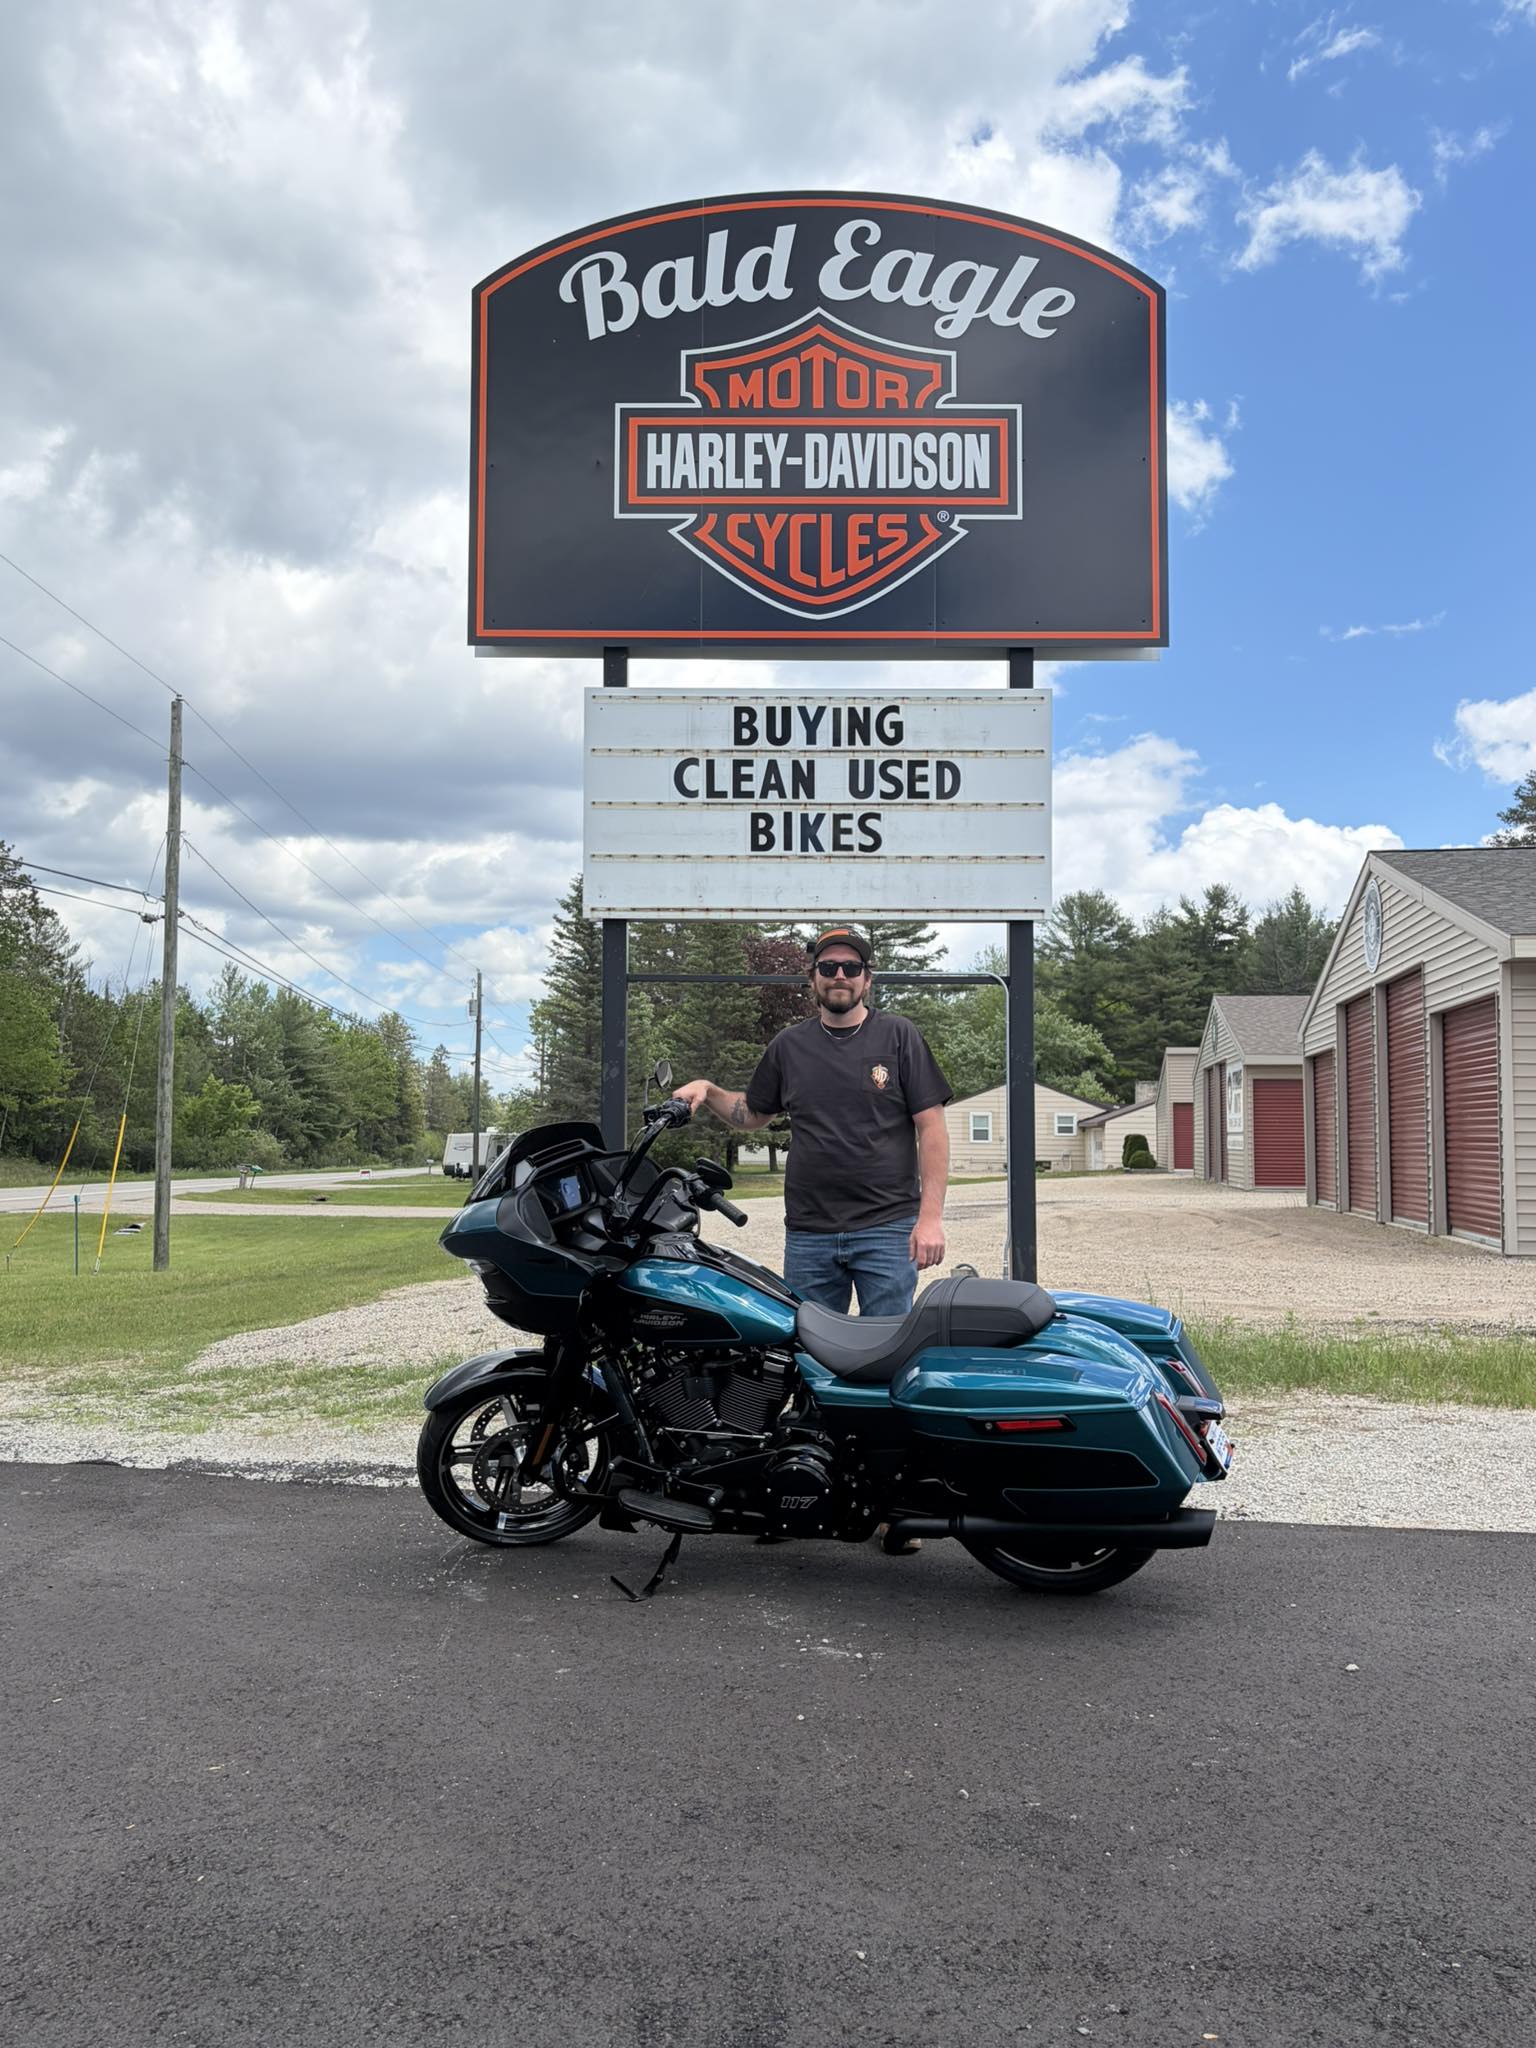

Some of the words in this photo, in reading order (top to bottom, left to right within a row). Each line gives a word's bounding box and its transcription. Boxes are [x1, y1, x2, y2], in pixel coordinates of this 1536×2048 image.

[559, 224, 797, 341] Bald
[818, 218, 1076, 339] Eagle
[729, 344, 909, 409] MOTOR
[646, 432, 991, 490] HARLEY-DAVIDSON
[726, 513, 908, 589] CYCLES
[733, 705, 904, 747] BUYING
[673, 757, 816, 800] CLEAN
[848, 758, 961, 800] USED
[750, 811, 882, 853] BIKES
